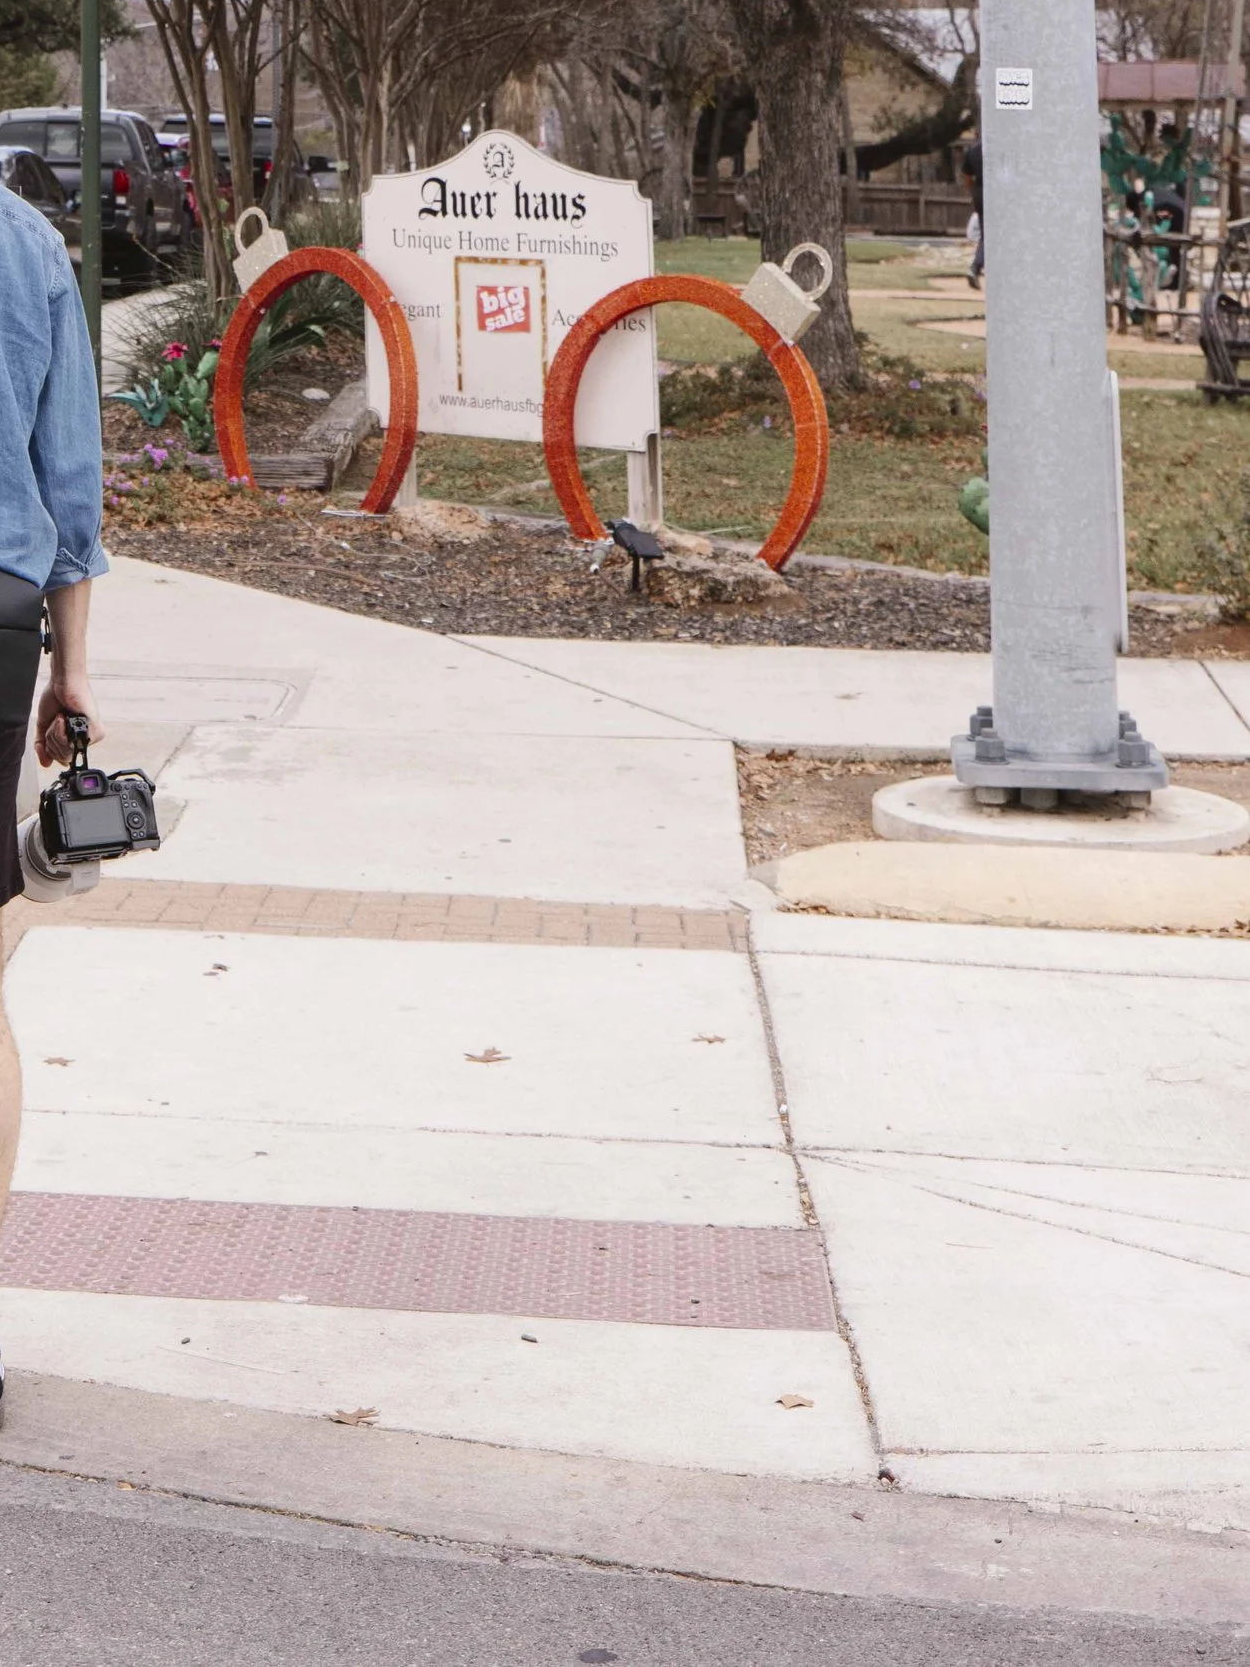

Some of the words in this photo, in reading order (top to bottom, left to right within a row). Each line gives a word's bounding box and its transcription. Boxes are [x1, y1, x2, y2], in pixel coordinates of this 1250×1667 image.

[418, 177, 498, 220] Auer
[514, 180, 587, 229] haus
[392, 228, 452, 256] Unique
[458, 230, 510, 252] Home
[516, 232, 619, 263] Furnishings
[480, 286, 525, 314] big
[485, 307, 526, 332] sale
